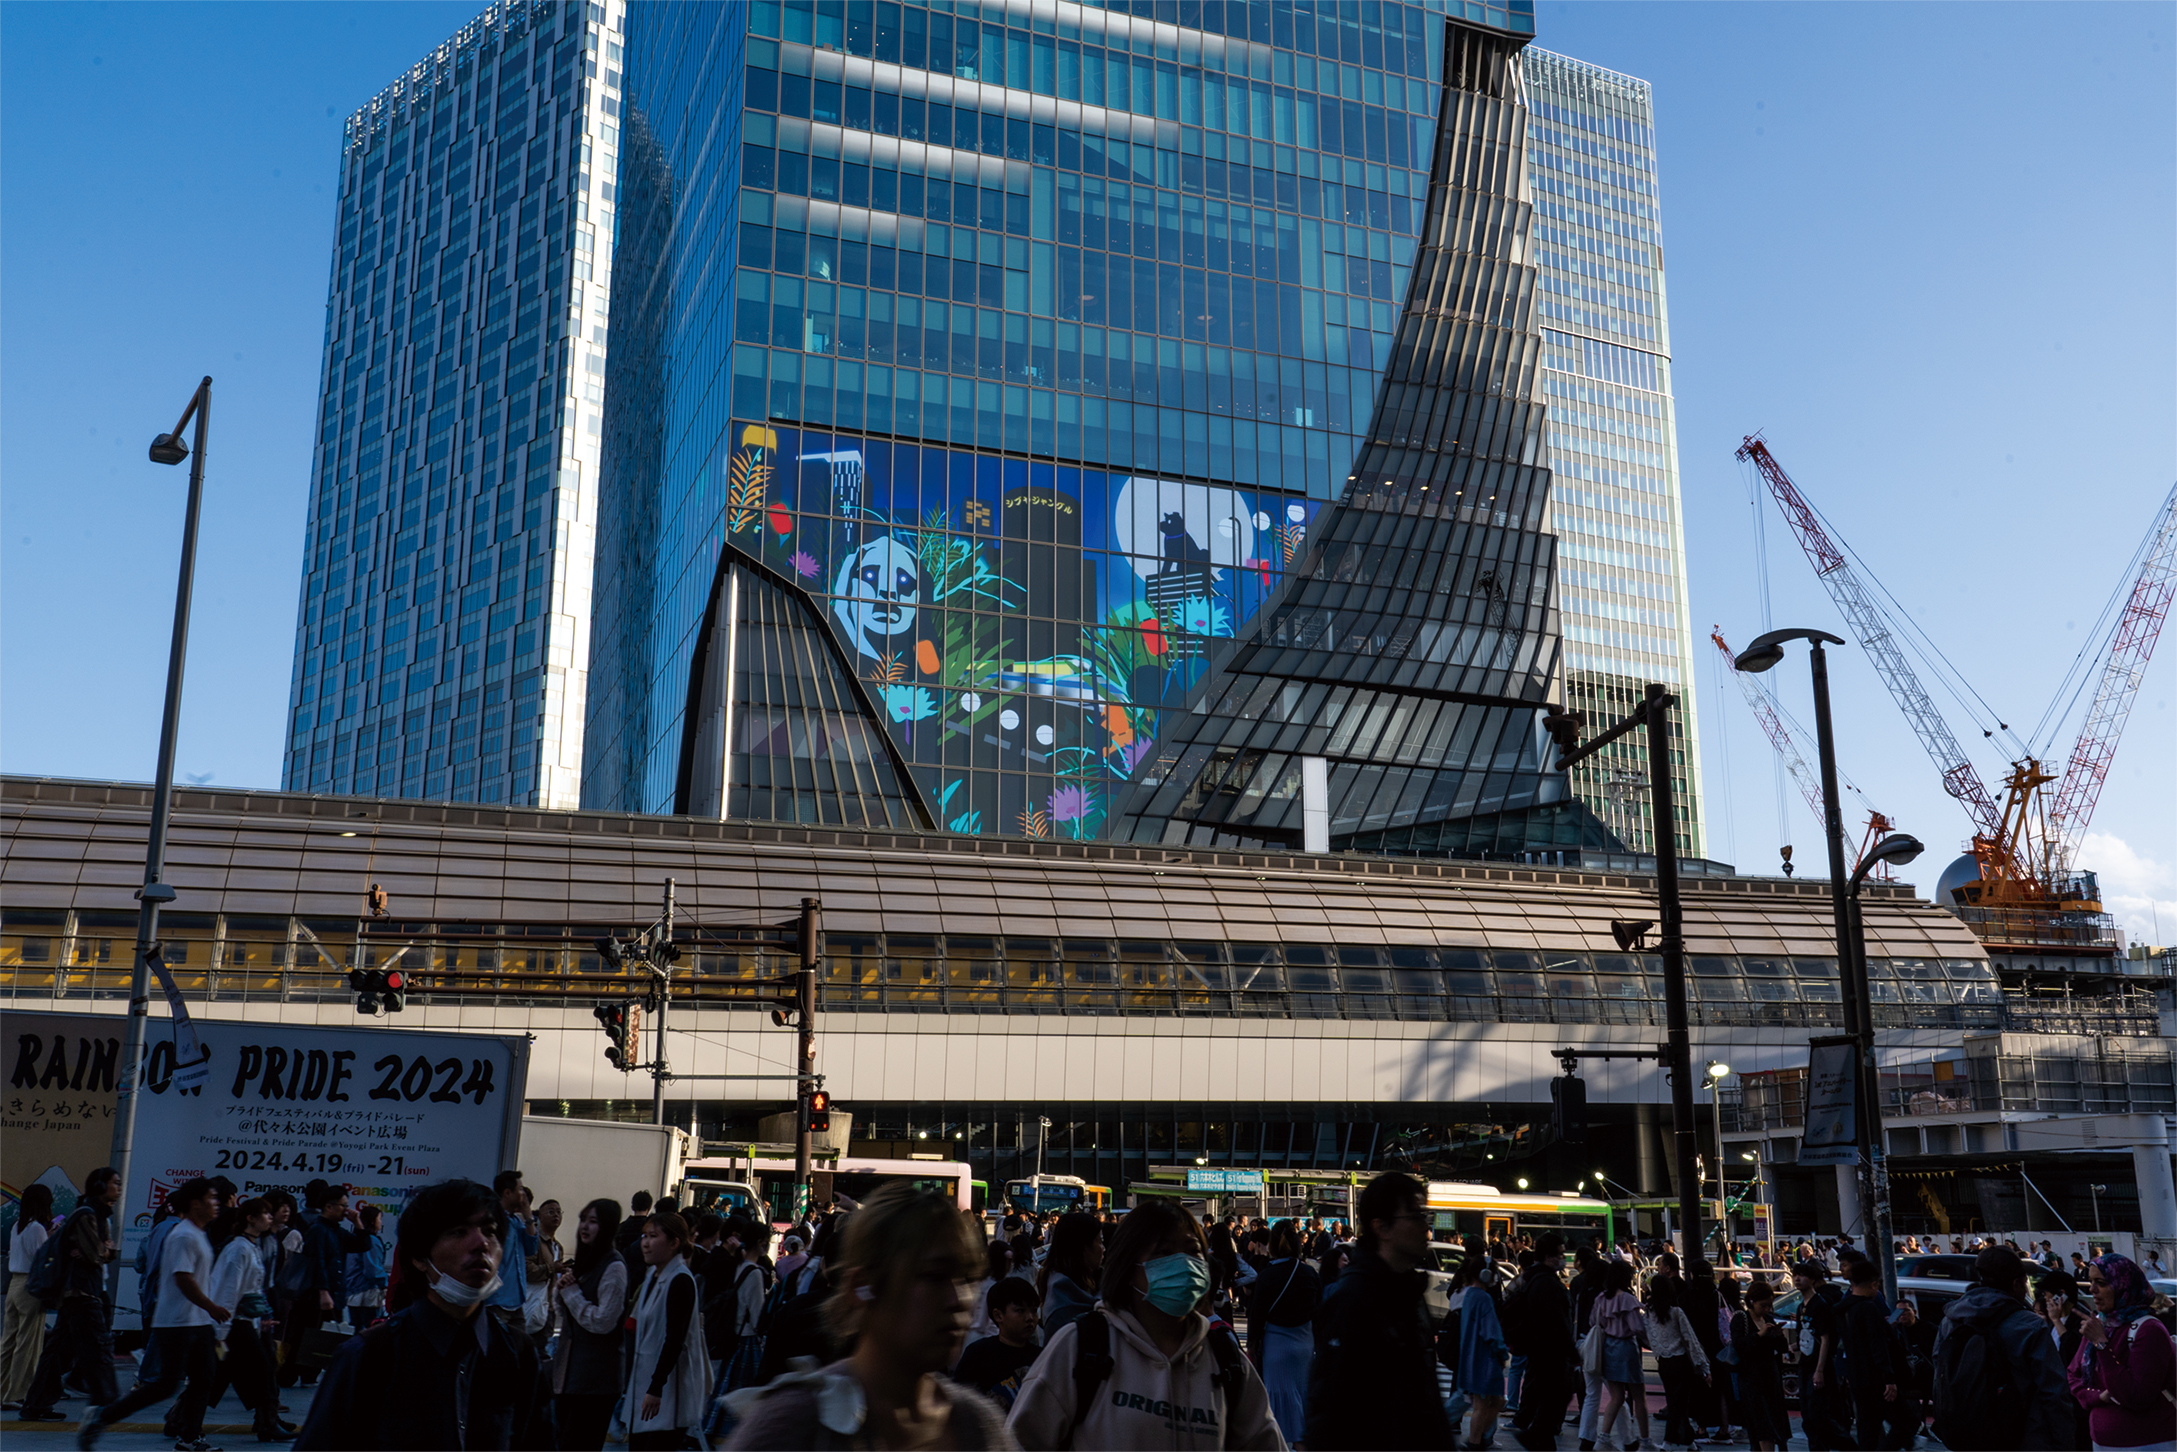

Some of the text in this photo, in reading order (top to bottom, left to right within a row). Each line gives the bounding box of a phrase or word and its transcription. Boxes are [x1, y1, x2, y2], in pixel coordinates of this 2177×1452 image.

[10, 1033, 495, 1106] RAINO PRIDE 2024
[0, 1097, 117, 1119] きらめない
[0, 1117, 82, 1132] hange Japan
[238, 1119, 408, 1140] @代々木公園イベント広場
[200, 1135, 223, 1144] Pride
[226, 1136, 260, 1146] Festival
[262, 1138, 269, 1146] &
[272, 1138, 296, 1147] Pride
[298, 1139, 328, 1148] Parade
[369, 1142, 389, 1151] Park
[391, 1143, 416, 1152] Event
[418, 1144, 441, 1153] Plaza
[165, 1168, 206, 1178] CHANGE
[1190, 1173, 1199, 1182] 51
[1227, 1174, 1236, 1183] 51
[244, 1181, 305, 1194] Panason
[1111, 1390, 1219, 1426] ORIGINAL
